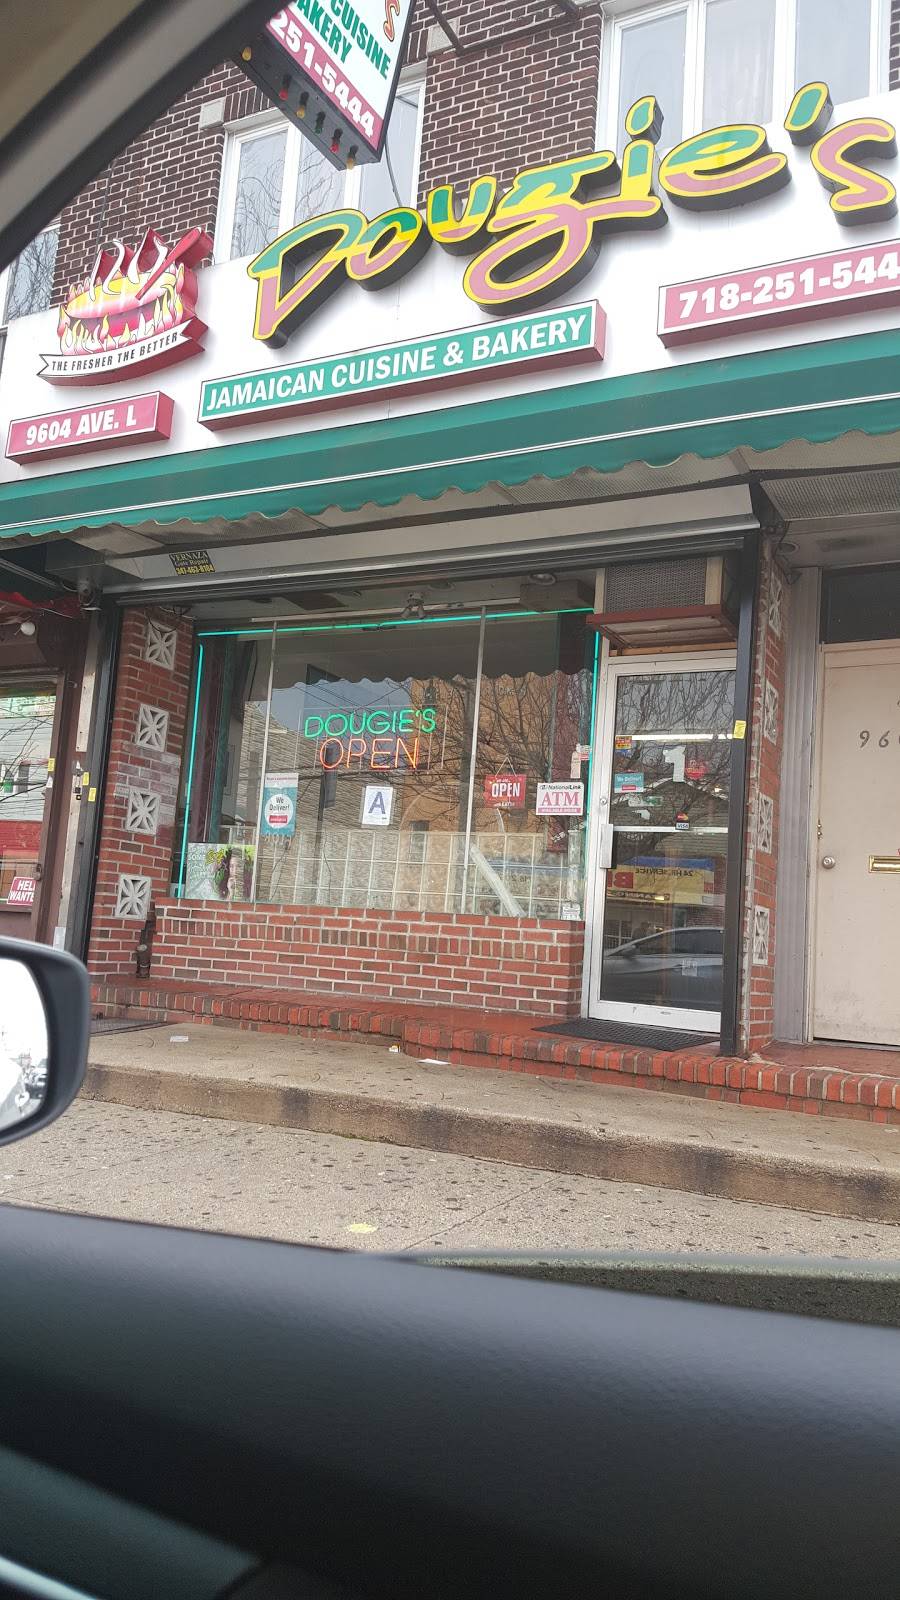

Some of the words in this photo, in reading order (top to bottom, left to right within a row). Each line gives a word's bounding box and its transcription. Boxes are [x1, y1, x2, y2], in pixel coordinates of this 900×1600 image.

[330, 0, 391, 80] CUISINE
[247, 81, 897, 341] Dougie's
[52, 361, 68, 371] THE
[71, 355, 113, 371] FRESHER
[117, 348, 135, 363] THE
[139, 332, 178, 356] BETTER
[206, 368, 325, 411] JAMAICAN
[331, 344, 436, 388] CUISINE
[442, 341, 464, 366] &
[471, 314, 587, 361] BAKERY
[26, 418, 71, 446] 9604
[76, 408, 119, 436] AVE.
[126, 404, 137, 426] L
[304, 708, 437, 738] DOUGIE'S
[859, 730, 900, 748] 96
[319, 737, 420, 769] OPEN
[367, 791, 386, 815] A
[491, 782, 520, 798] OPEN
[541, 791, 580, 807] ATM
